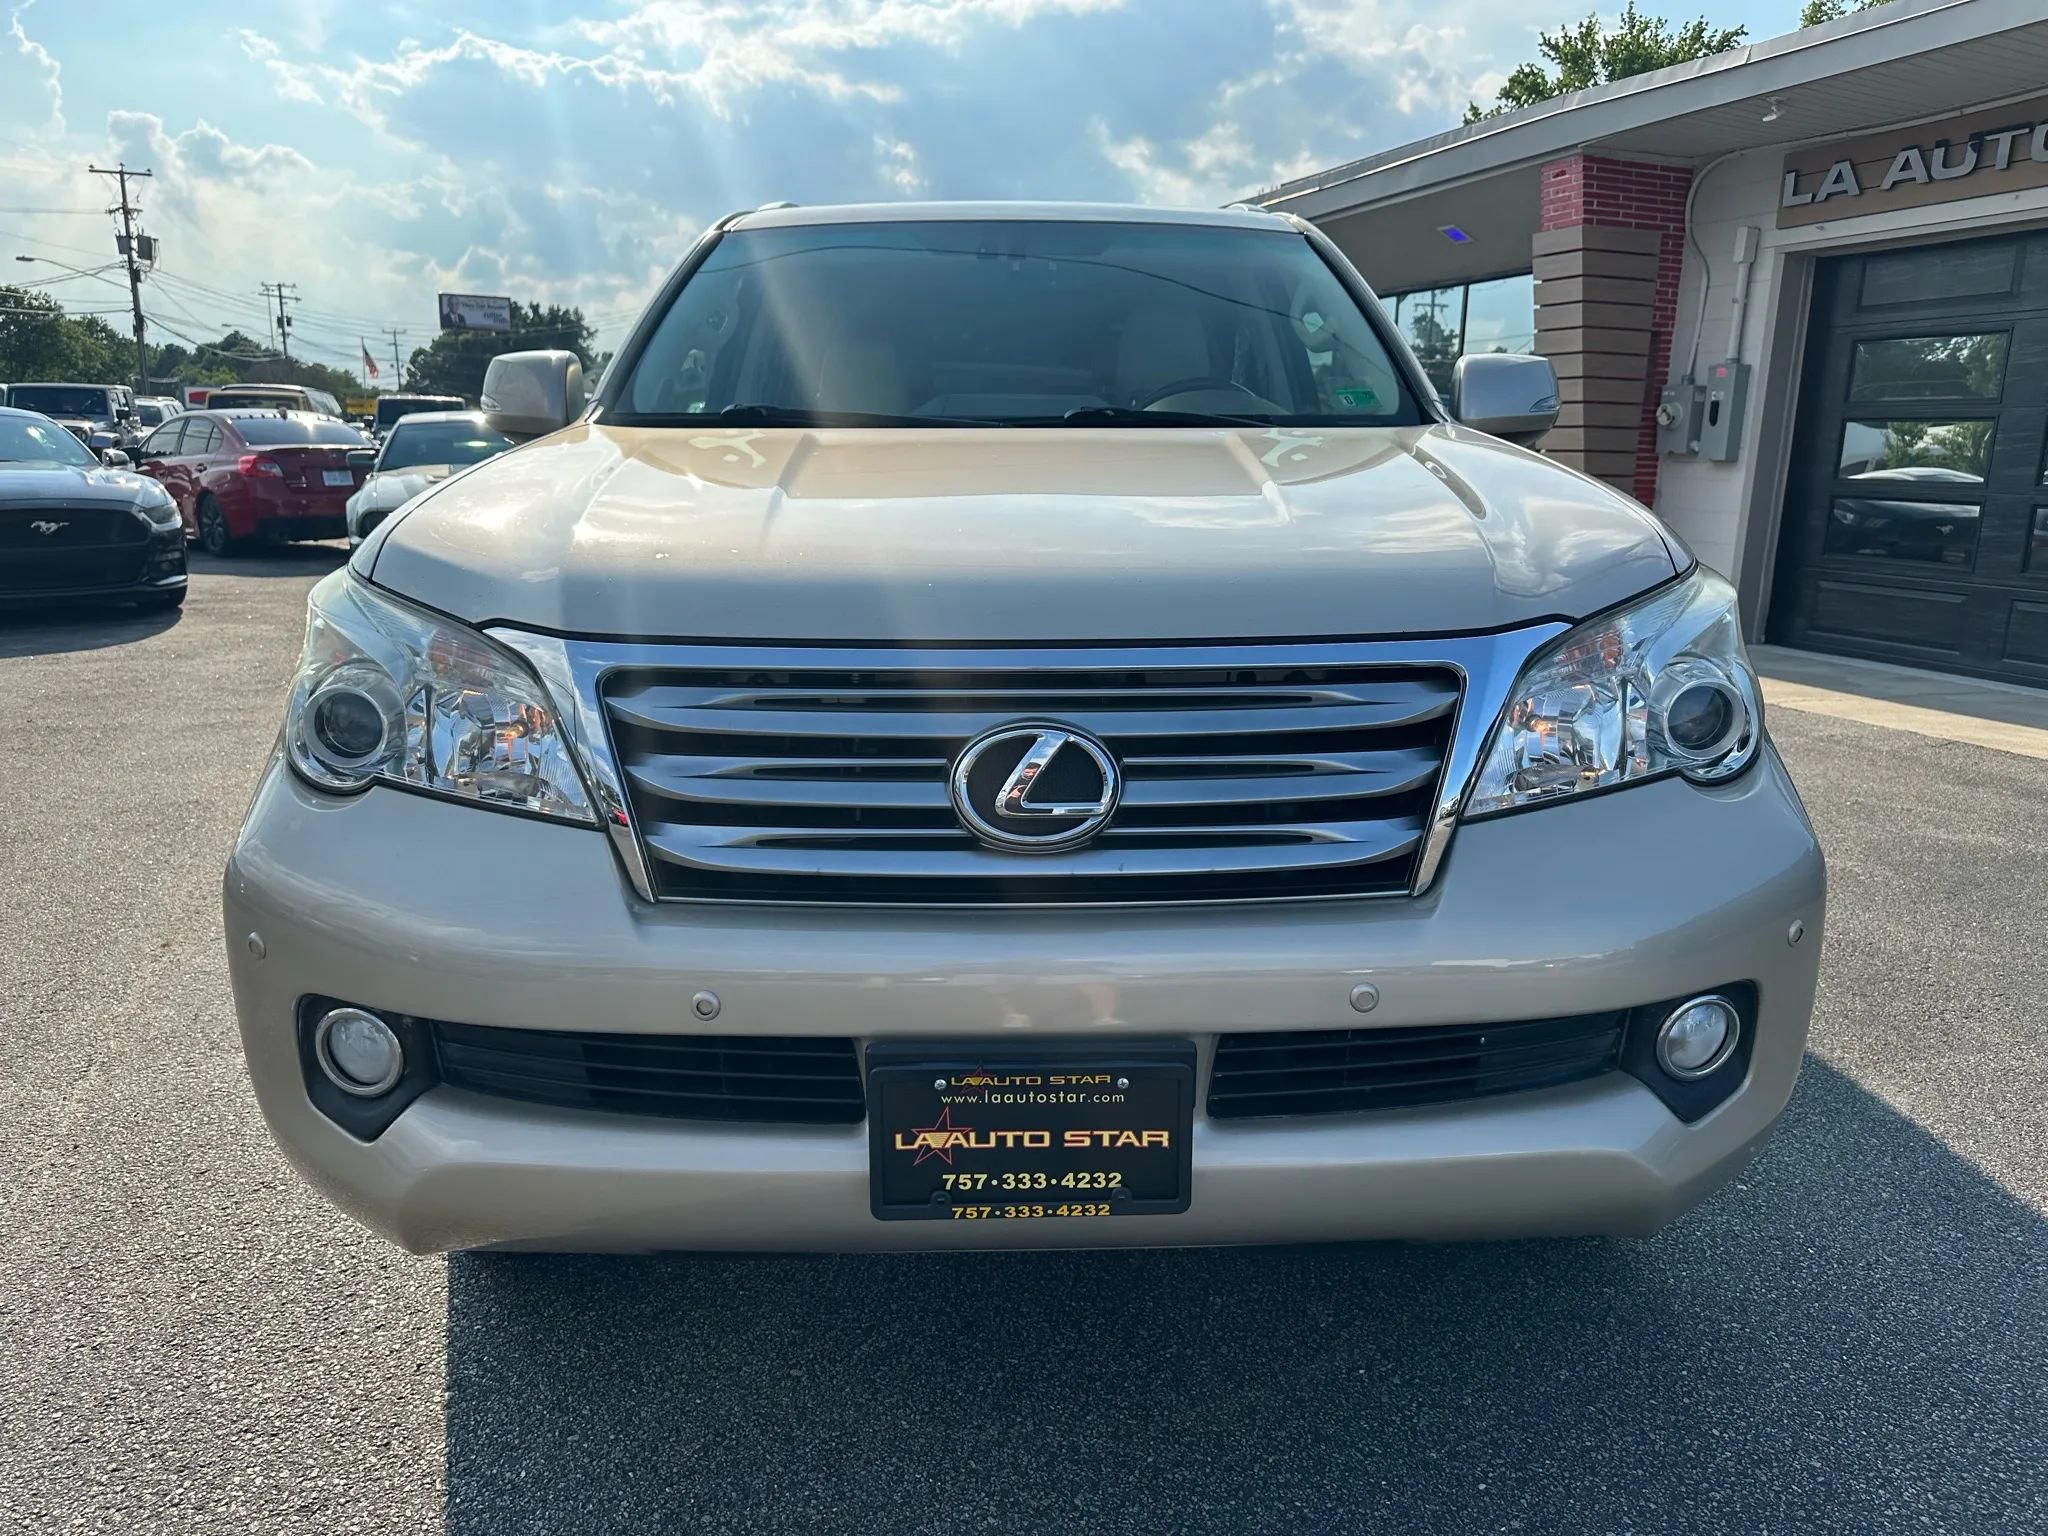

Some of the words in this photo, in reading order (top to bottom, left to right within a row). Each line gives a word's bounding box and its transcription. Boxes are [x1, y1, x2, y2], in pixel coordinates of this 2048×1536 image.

[1782, 160, 1860, 208] LA
[1049, 1074, 1111, 1085] STAR
[940, 1089, 1125, 1104] www.laautostar.com
[1063, 1130, 1170, 1149] STAR
